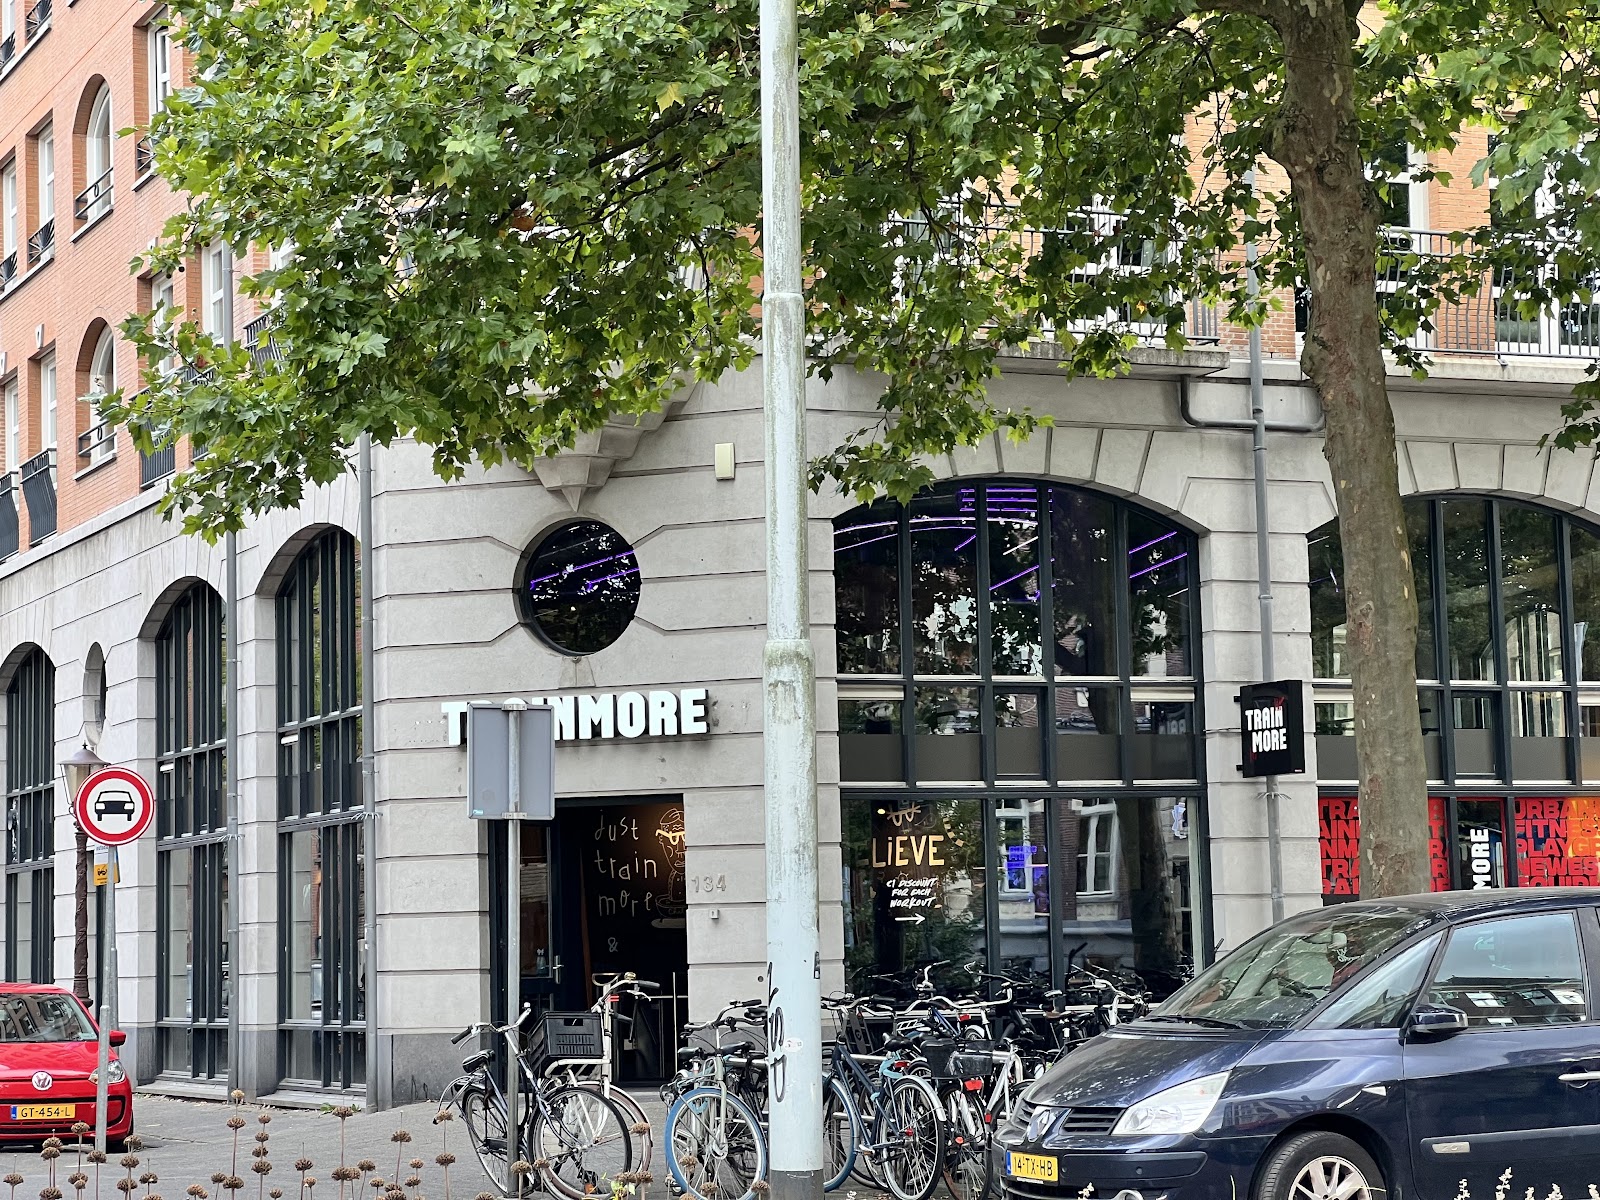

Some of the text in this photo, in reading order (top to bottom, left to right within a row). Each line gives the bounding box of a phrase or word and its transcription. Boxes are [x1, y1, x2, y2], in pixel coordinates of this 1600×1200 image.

[441, 688, 708, 746] TNMORE
[1245, 705, 1284, 731] TRAIN
[1251, 728, 1288, 753] MORE
[594, 849, 657, 880] train
[691, 874, 727, 893] 134
[891, 888, 931, 897] FOR EACH
[898, 877, 938, 888] DISCOUNT
[598, 889, 653, 917] more
[890, 897, 936, 909] WORKOUT
[20, 1107, 71, 1118] GT-454-L
[1013, 1155, 1053, 1177] 14-TX-HB
